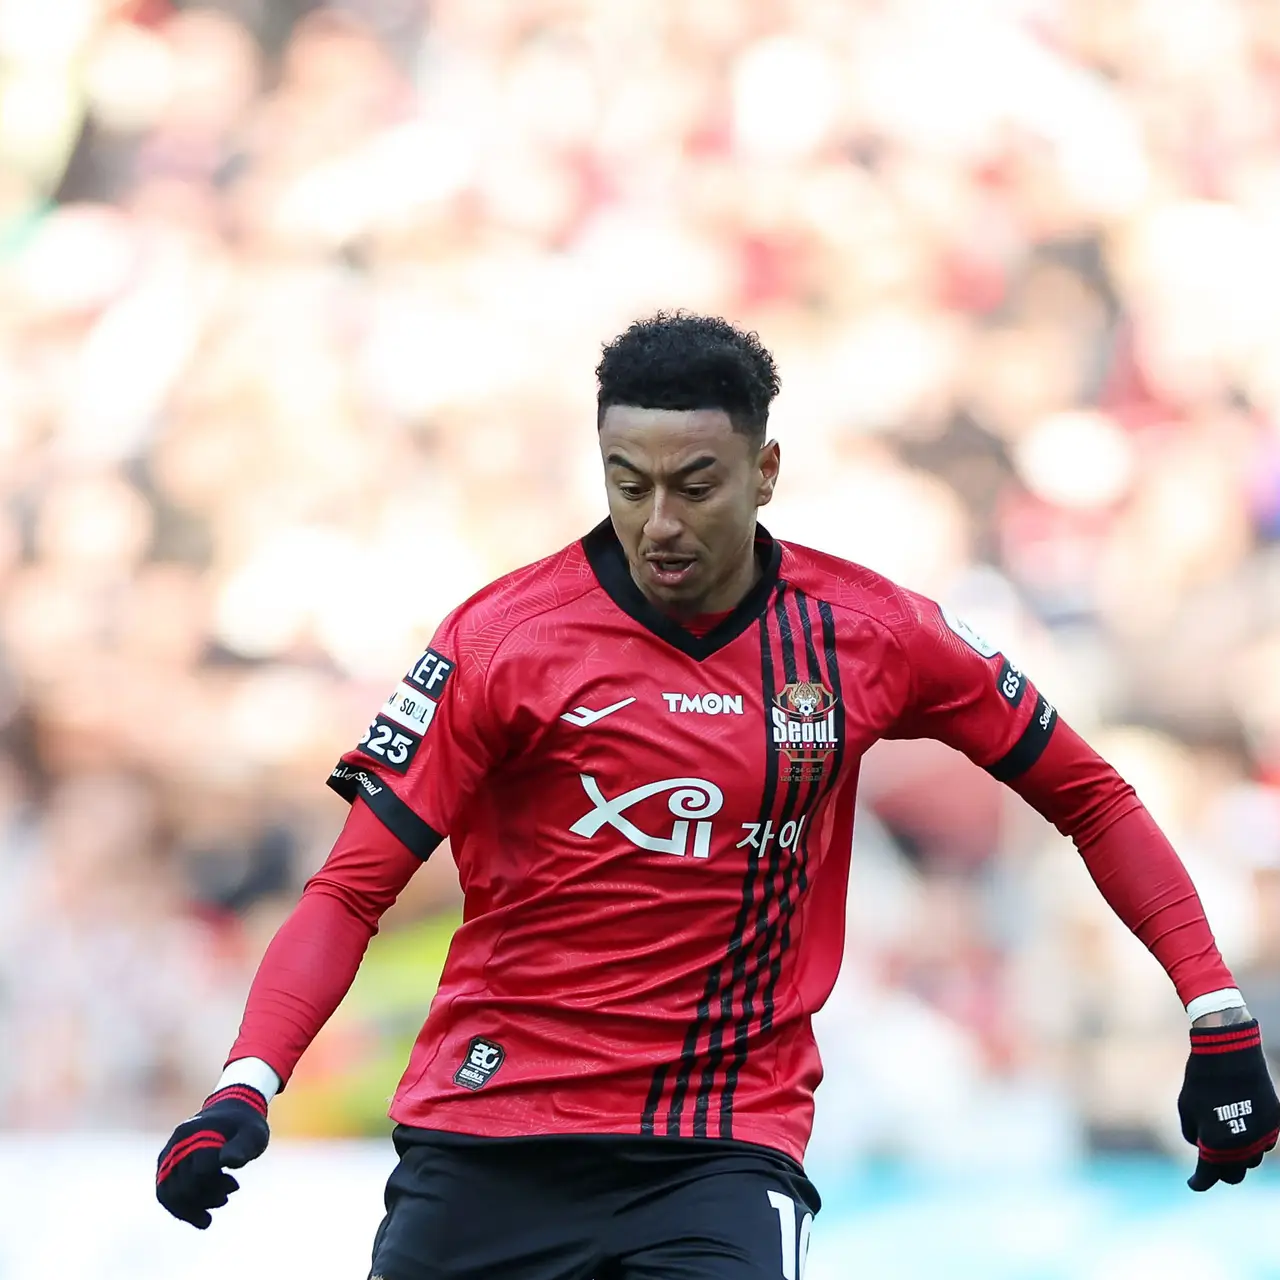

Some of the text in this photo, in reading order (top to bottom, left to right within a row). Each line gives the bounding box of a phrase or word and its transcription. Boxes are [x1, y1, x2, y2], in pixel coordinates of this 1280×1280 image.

[661, 693, 744, 715] TMON
[771, 706, 838, 743] Seoul
[355, 771, 383, 797] Seoul
[735, 814, 806, 858] 자이
[1212, 1099, 1253, 1122] SEOUL
[1226, 1117, 1247, 1135] FC
